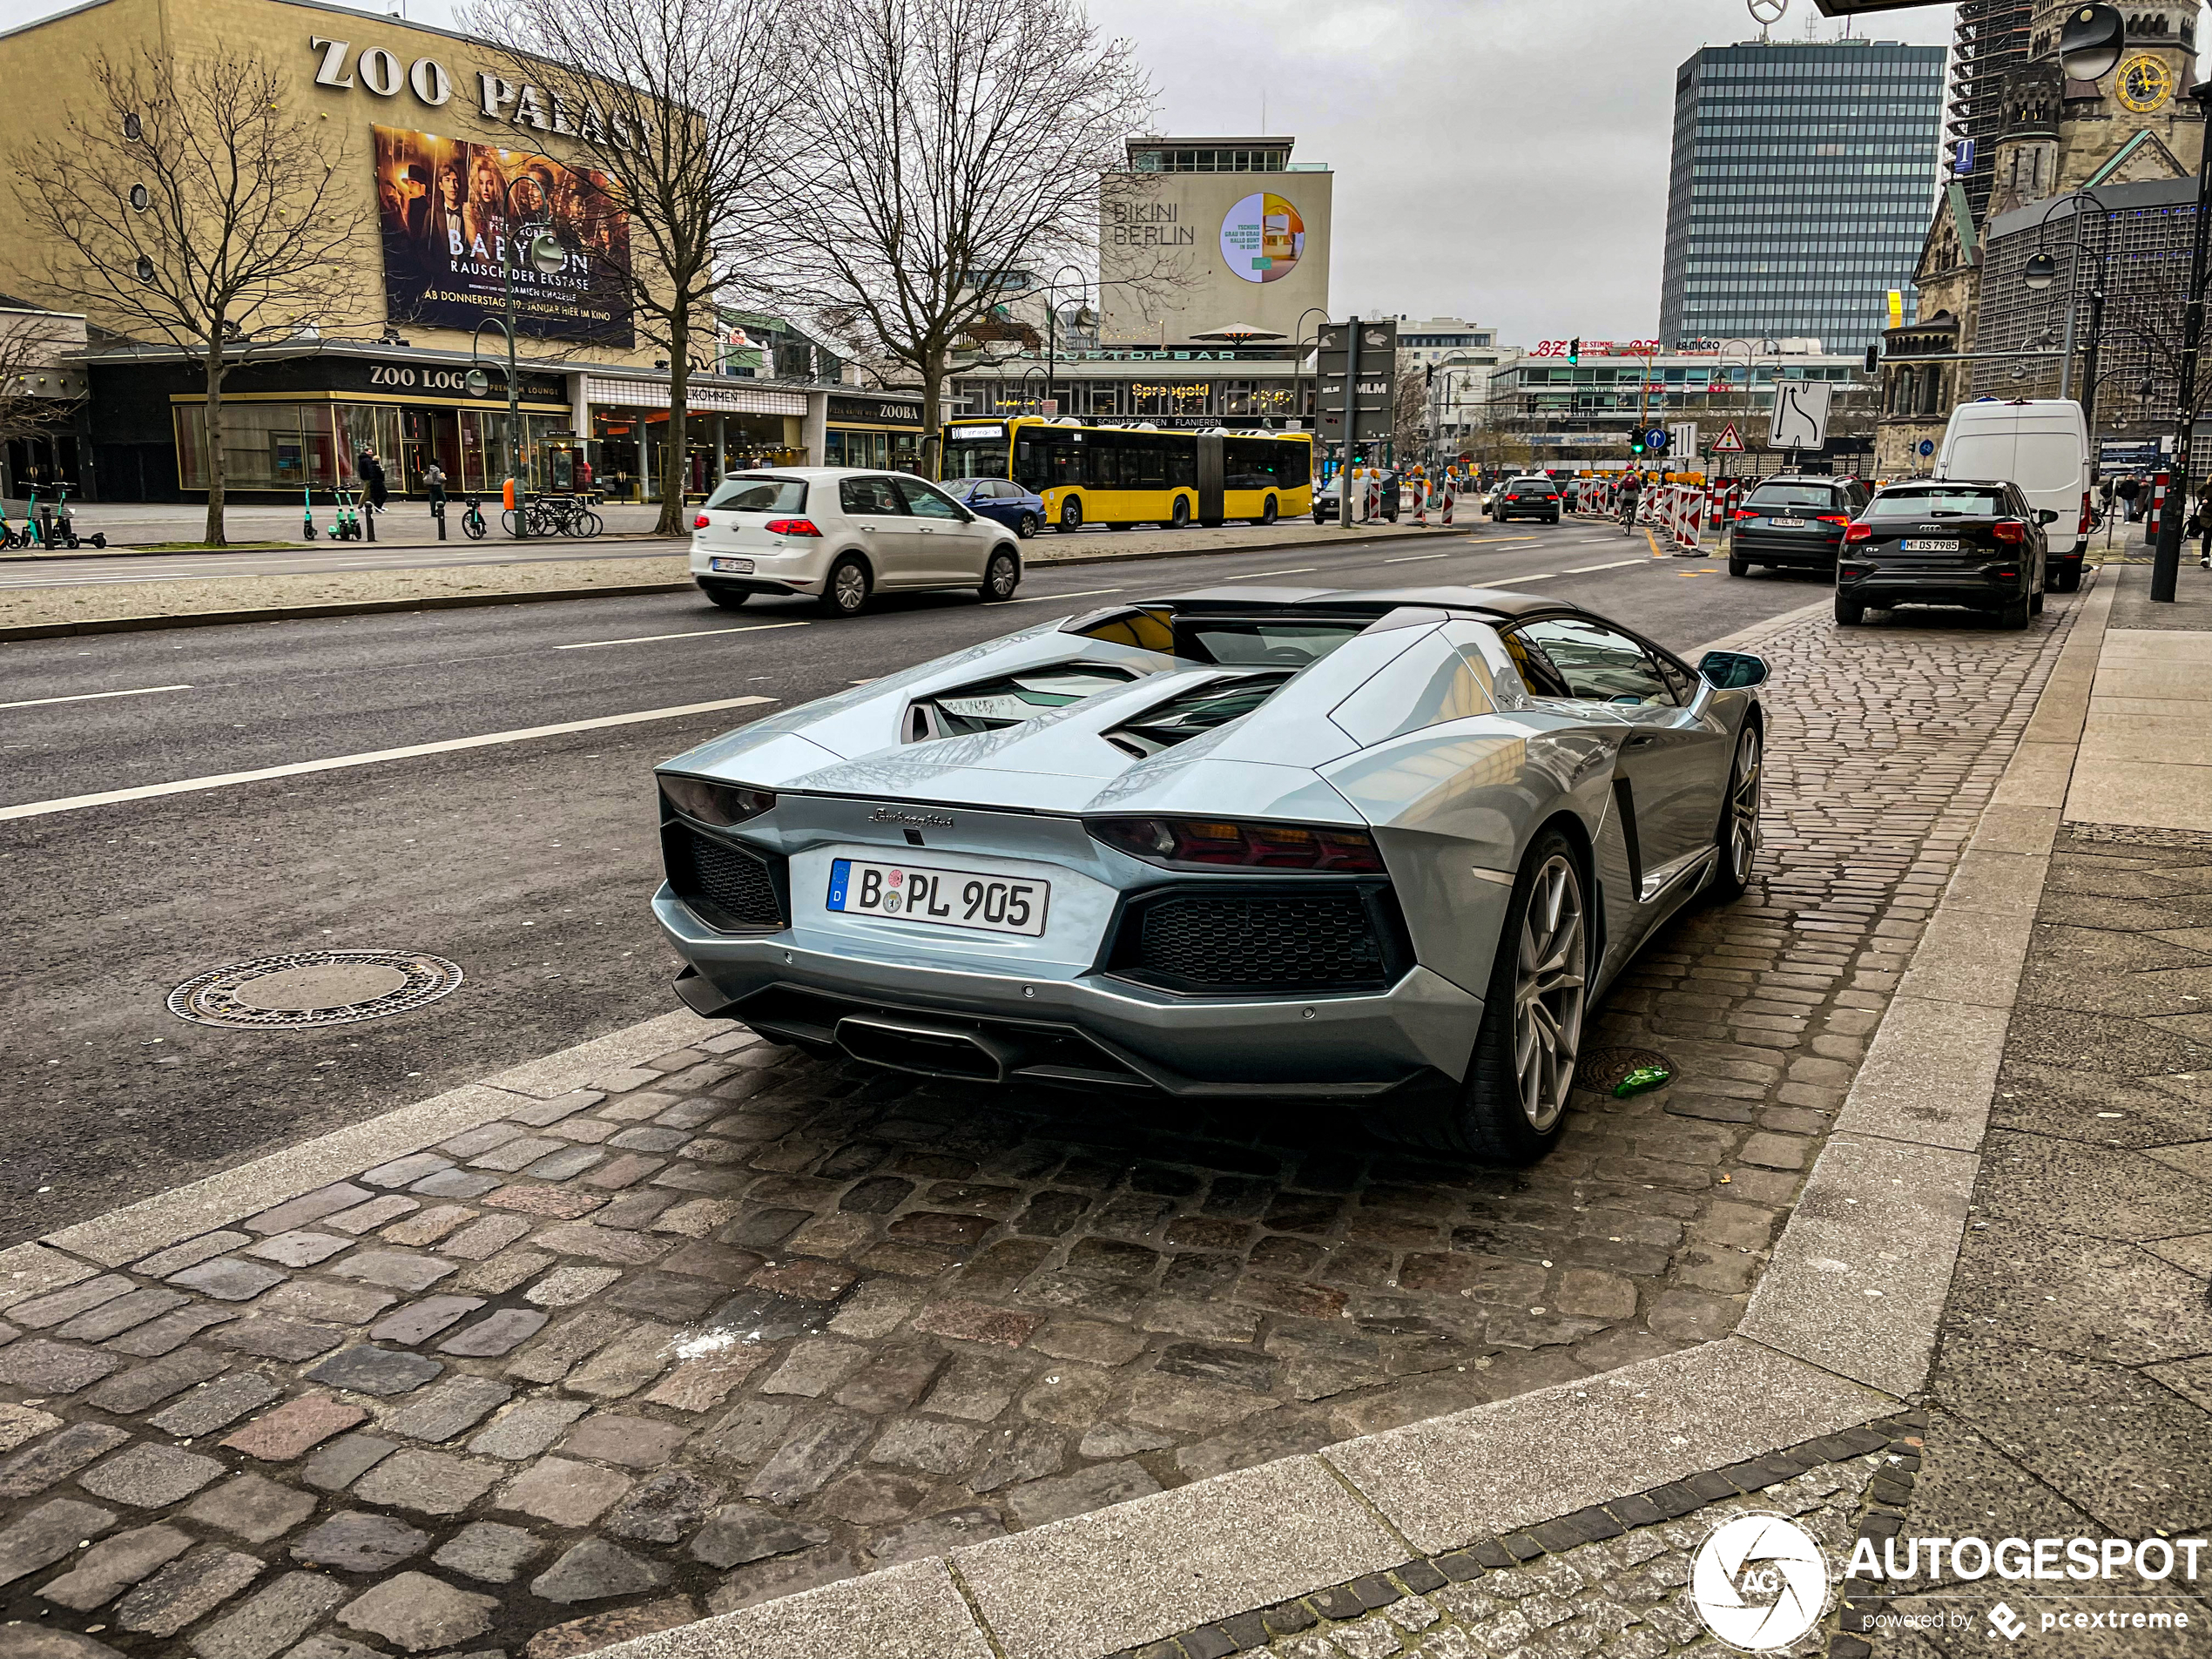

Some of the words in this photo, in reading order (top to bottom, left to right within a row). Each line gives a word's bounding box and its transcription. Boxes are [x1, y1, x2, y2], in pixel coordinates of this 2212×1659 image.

[310, 35, 452, 105] ZOO
[1114, 203, 1177, 223] BIKINI
[1114, 226, 1194, 245] BERLIN
[450, 260, 506, 279] RAUSCH
[512, 268, 536, 283] DER
[541, 273, 589, 291] EKSTASE
[424, 290, 438, 300] AB
[526, 302, 560, 314] JANUAR
[562, 306, 578, 316] HIER
[580, 307, 590, 318] IM
[591, 309, 610, 321] KINO
[370, 366, 415, 386] ZOO
[421, 369, 467, 389] LOG
[528, 387, 558, 395] LOUNGE
[1356, 382, 1387, 395] MLM
[1176, 418, 1222, 427] FLANIEREN
[1919, 541, 1932, 550] DS
[1933, 541, 1959, 550] 7985
[868, 807, 954, 828] Lamborghini
[833, 890, 841, 901] D
[860, 869, 881, 908] B
[906, 873, 950, 917] PL
[962, 880, 1034, 926] 905
